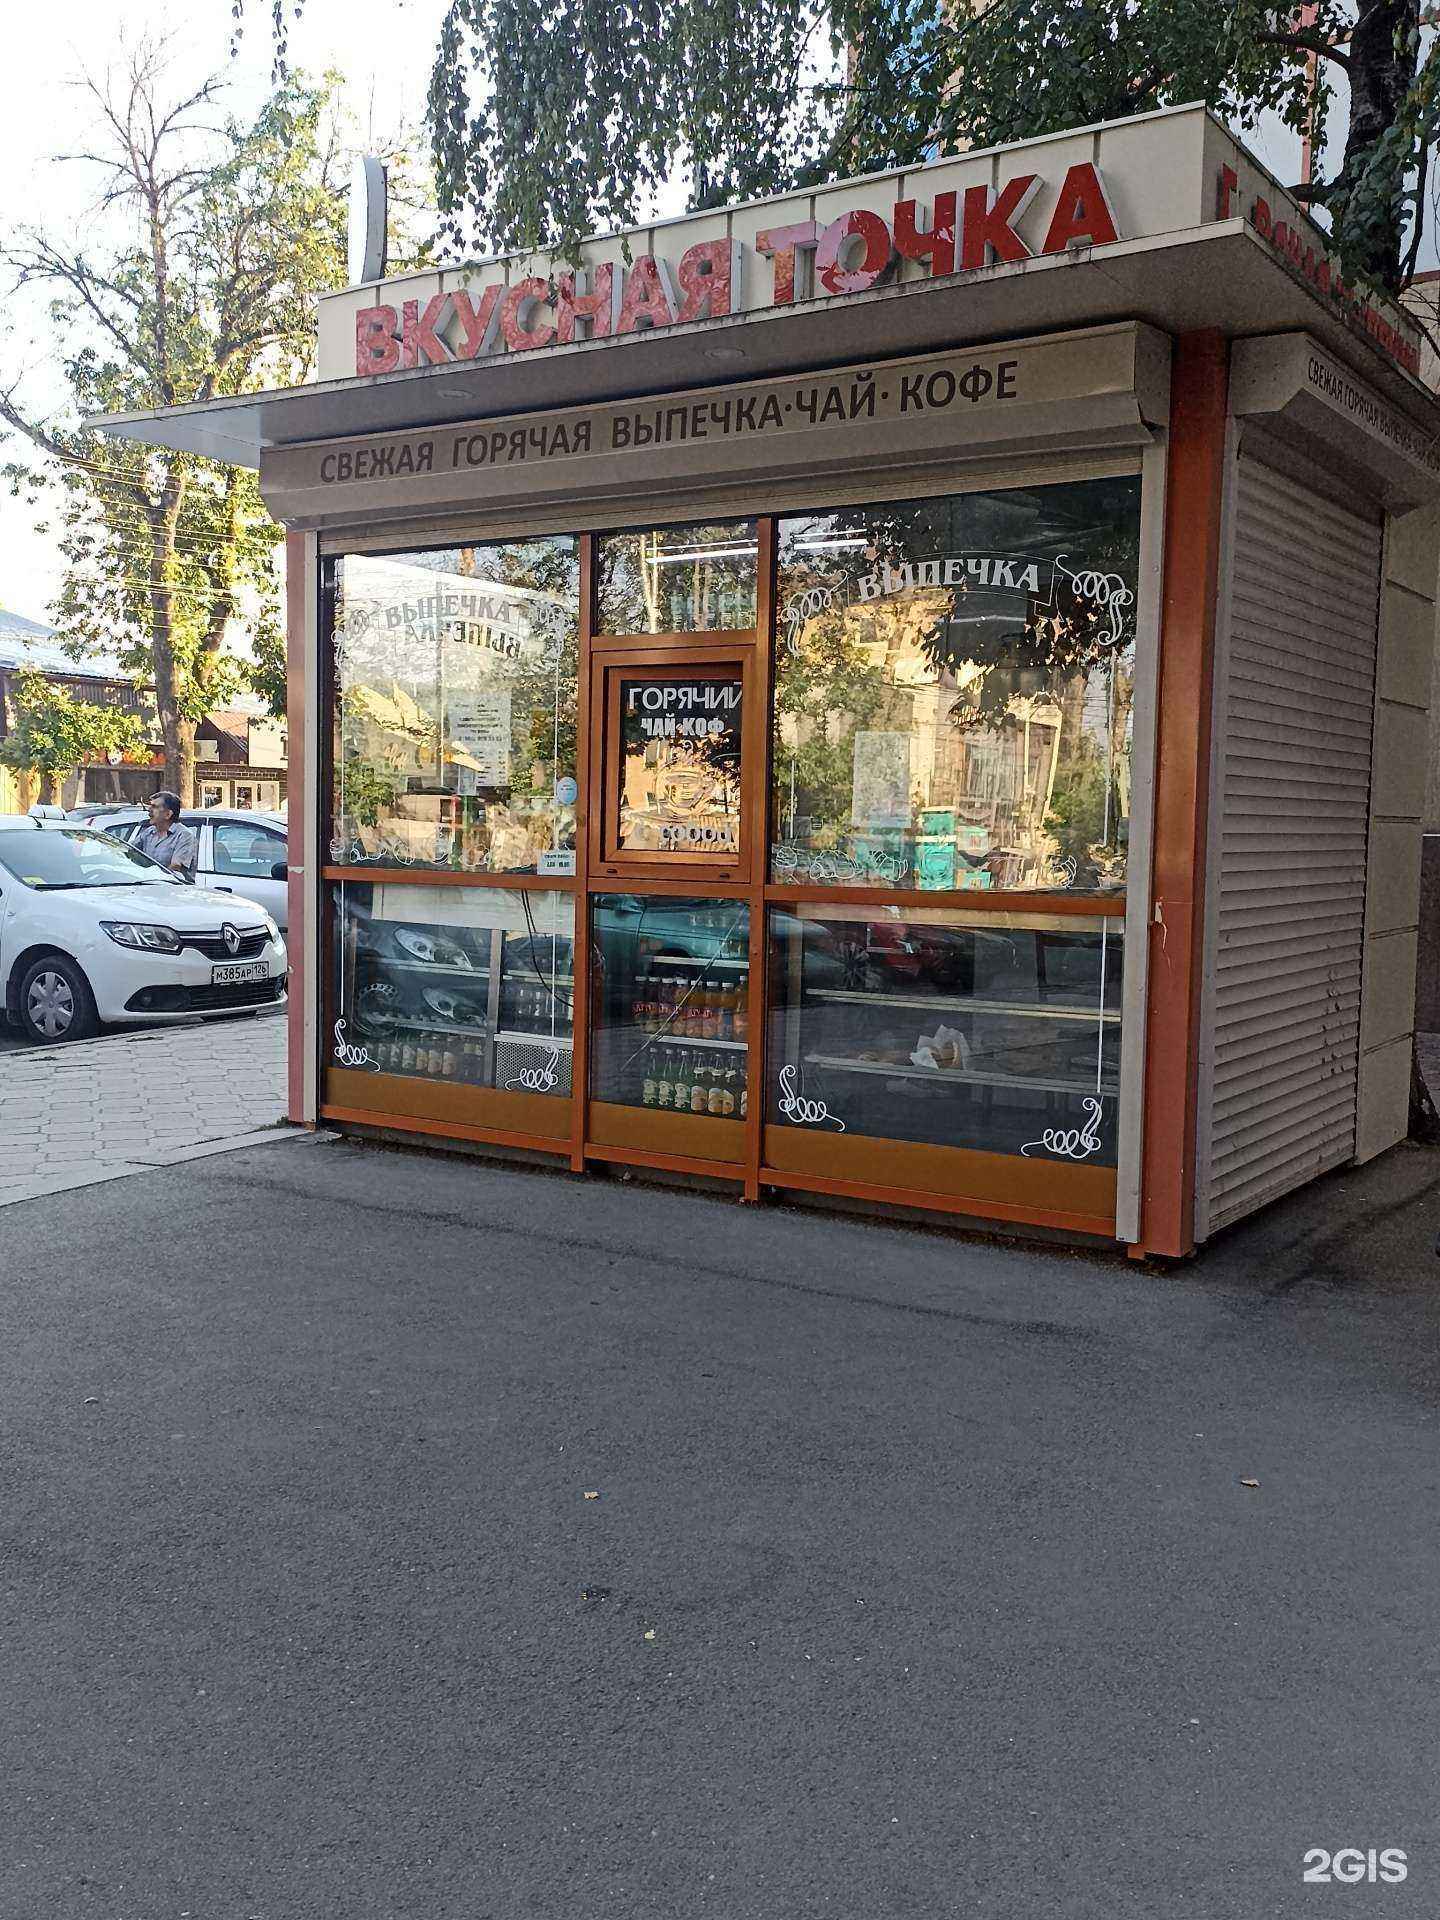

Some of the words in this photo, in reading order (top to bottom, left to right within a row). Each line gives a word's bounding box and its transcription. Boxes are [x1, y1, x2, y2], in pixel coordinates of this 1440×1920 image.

[356, 237, 736, 377] ВКУСНАЯ
[756, 162, 1119, 306] ТОЧКА
[1308, 356, 1343, 403] СВЕЖАЯ
[320, 441, 434, 484] СВЕЖАЯ
[452, 421, 592, 468] ГОРЯЧАЯ
[900, 360, 1018, 412] КОФЕ
[857, 559, 1040, 601] ВЫПЕЧКА
[385, 595, 511, 629] ВЫПЕЧКА
